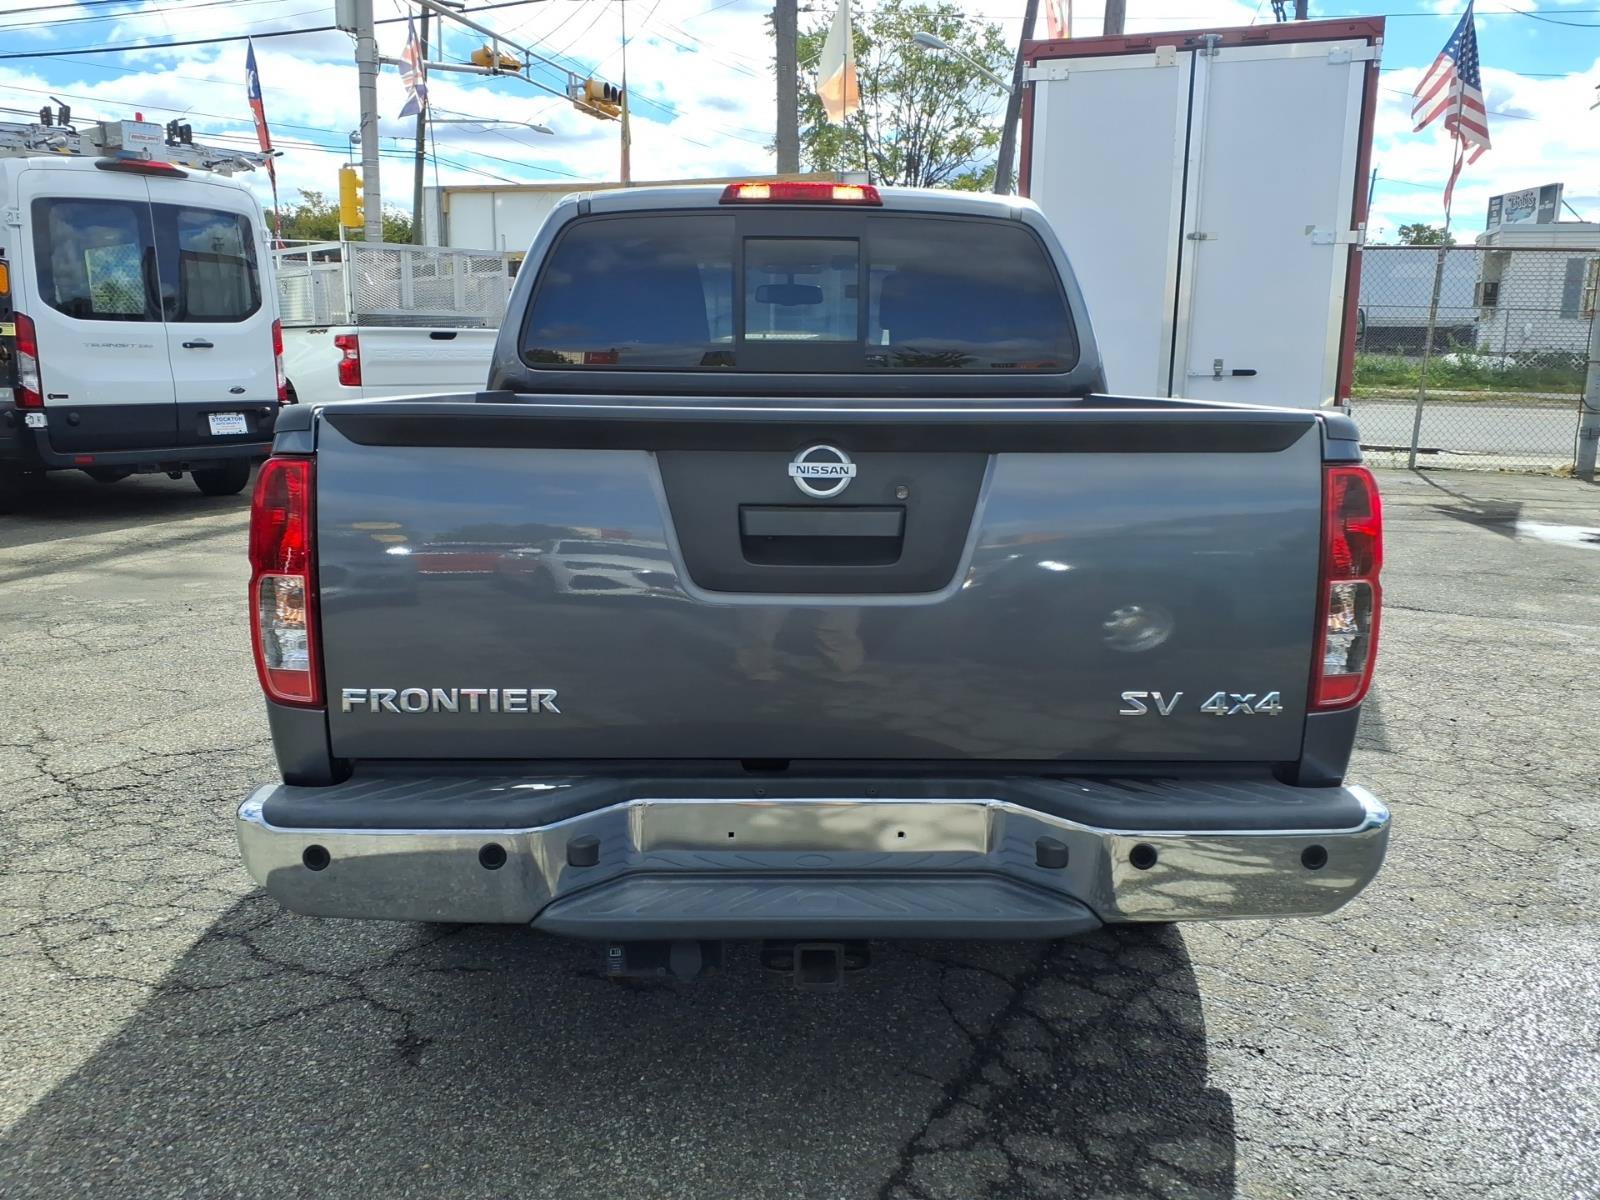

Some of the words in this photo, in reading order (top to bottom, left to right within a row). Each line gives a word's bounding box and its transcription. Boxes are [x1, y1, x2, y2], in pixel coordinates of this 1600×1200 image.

[796, 465, 849, 475] NISSAN
[341, 687, 561, 714] FRONTIER
[1119, 691, 1184, 716] SV
